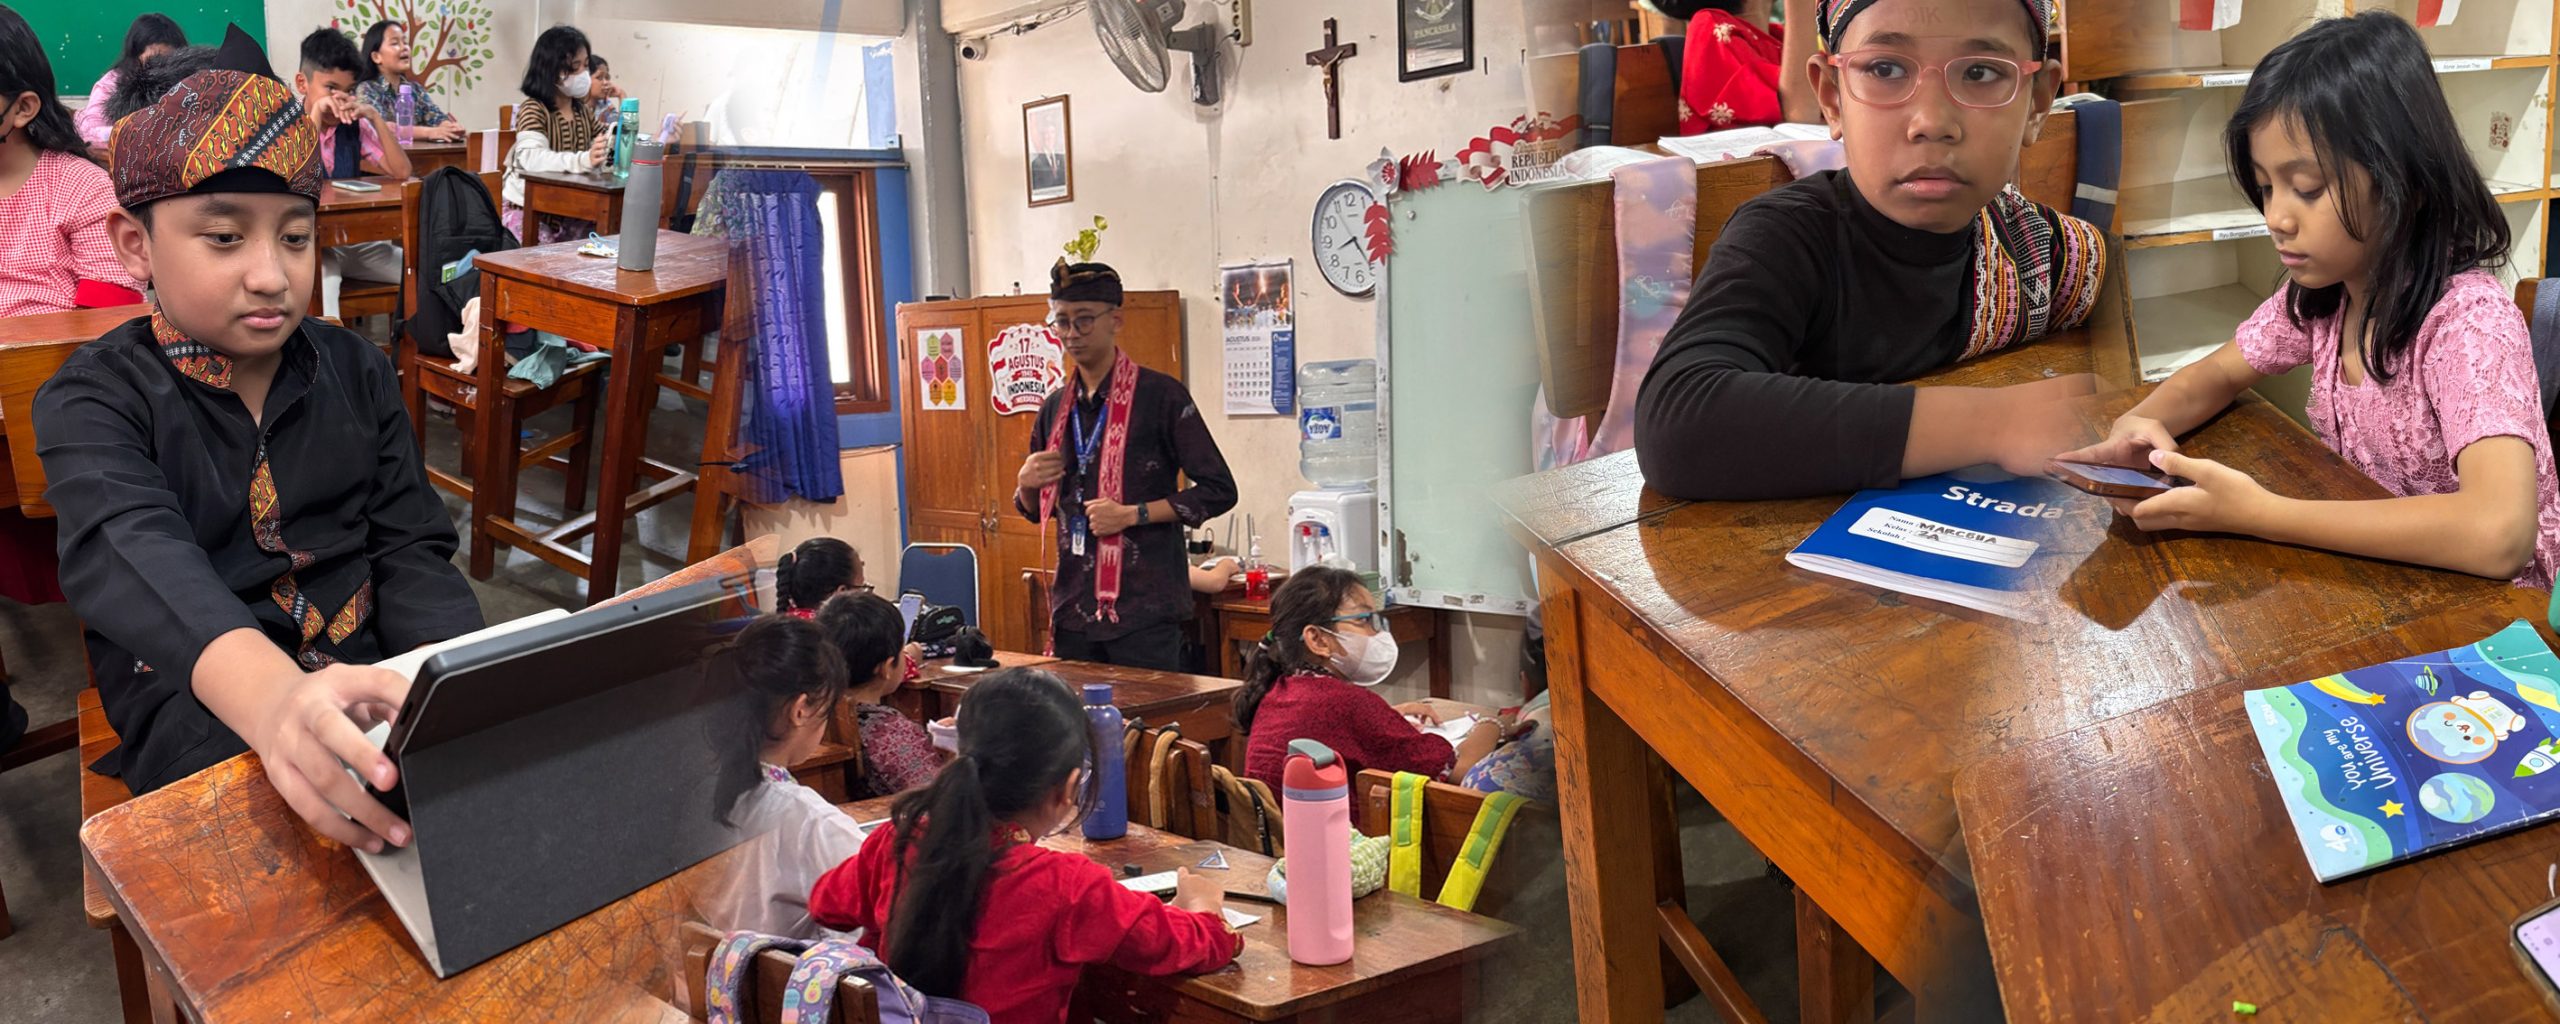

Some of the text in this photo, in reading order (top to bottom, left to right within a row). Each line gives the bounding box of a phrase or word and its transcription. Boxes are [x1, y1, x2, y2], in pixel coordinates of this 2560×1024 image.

[1510, 163, 1566, 182] INDONESIA
[1334, 200, 1341, 214] 11
[1343, 192, 1356, 207] 12
[1361, 196, 1366, 209] 1
[1325, 215, 1337, 229] 10
[1321, 235, 1333, 249] 9
[1329, 253, 1340, 268] 8
[1341, 265, 1350, 280] 7
[1355, 269, 1365, 284] 6
[1018, 338, 1030, 353] 17
[1008, 354, 1045, 370] AGUSTUS
[1007, 381, 1046, 395] INDONESIA
[1941, 485, 2064, 519] Strada
[1884, 522, 1908, 532] Kelas
[1889, 515, 1914, 526] Nama
[1866, 527, 1901, 540] Sekolah
[1918, 530, 1940, 541] 2A
[2323, 728, 2368, 791] You are my
[2340, 716, 2398, 790] Universe
